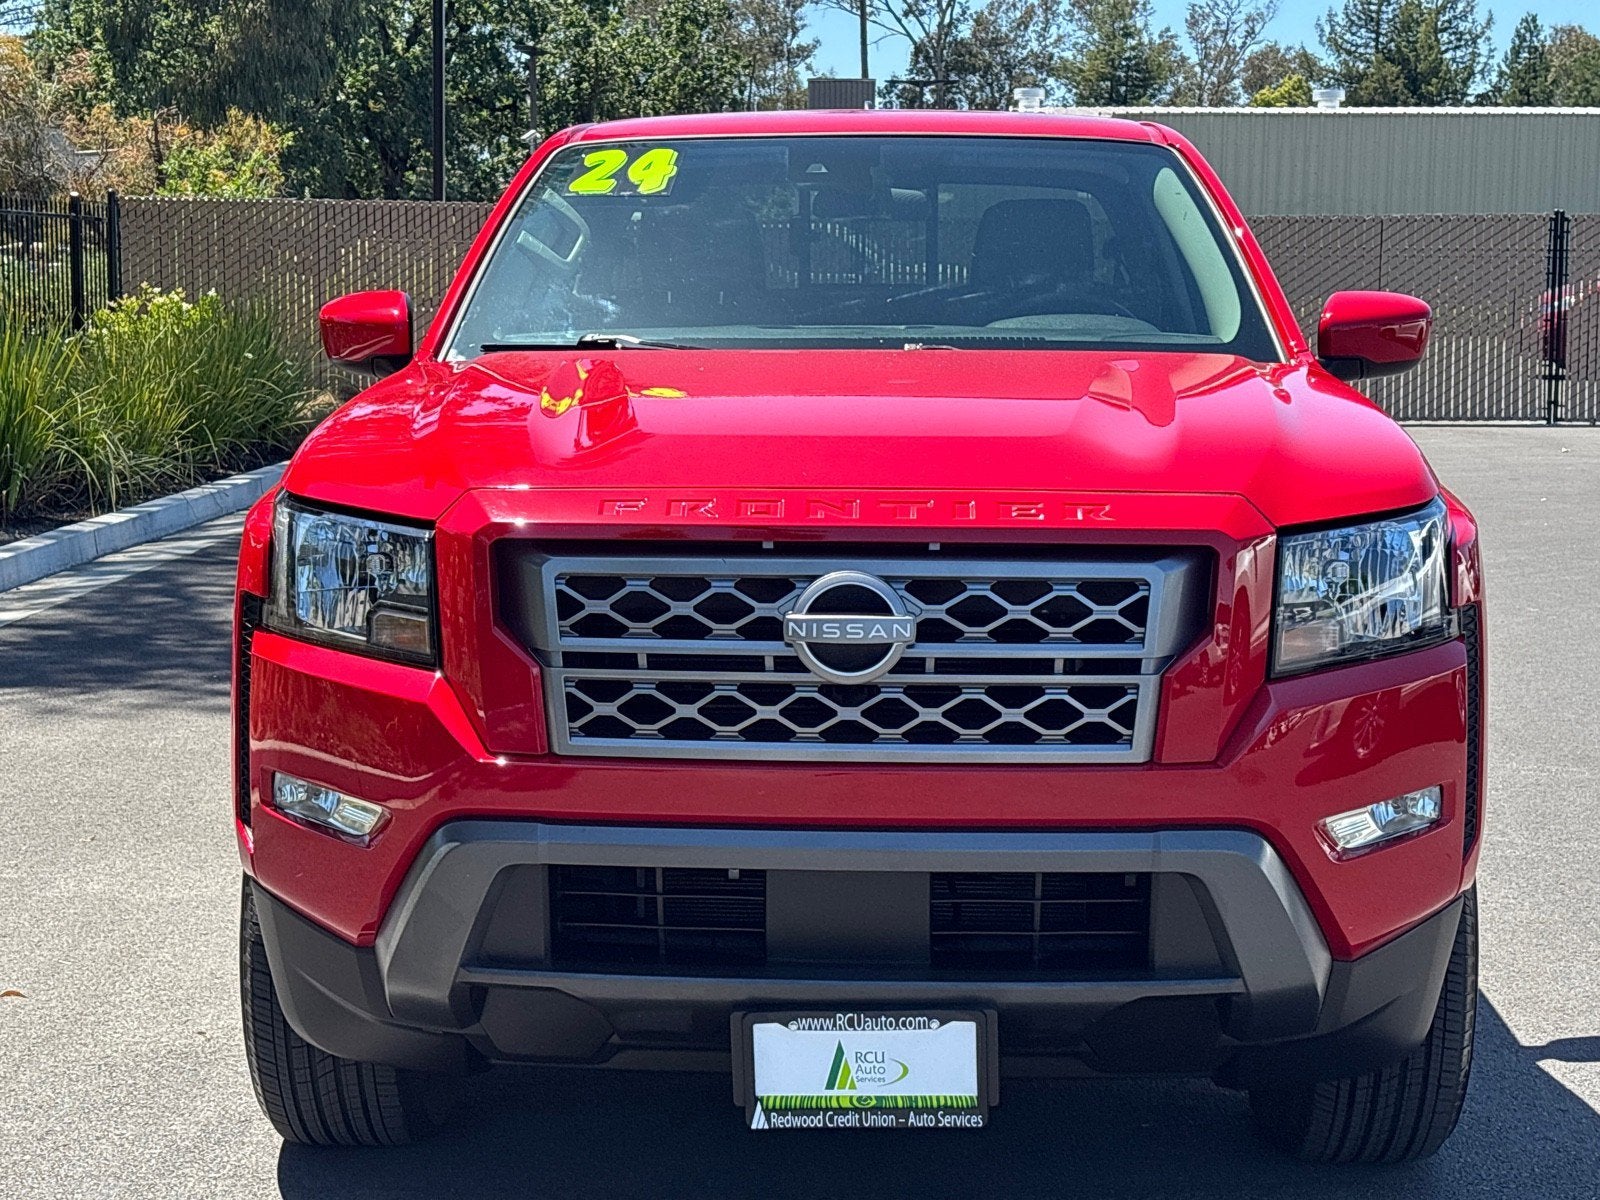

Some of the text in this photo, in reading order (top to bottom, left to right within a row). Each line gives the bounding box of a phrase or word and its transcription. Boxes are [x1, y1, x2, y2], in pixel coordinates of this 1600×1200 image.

[568, 148, 679, 194] 24
[599, 497, 1116, 522] FRONTIER
[788, 620, 912, 640] NISSAN
[797, 1013, 929, 1031] www.RCUauto.com
[854, 1051, 886, 1064] RCU
[855, 1064, 886, 1075] Auto
[855, 1075, 886, 1083] Services
[770, 1111, 823, 1127] Redwood
[825, 1111, 860, 1127] Credit
[862, 1111, 896, 1127] Union
[907, 1110, 936, 1127] Auto
[938, 1110, 983, 1127] Services
